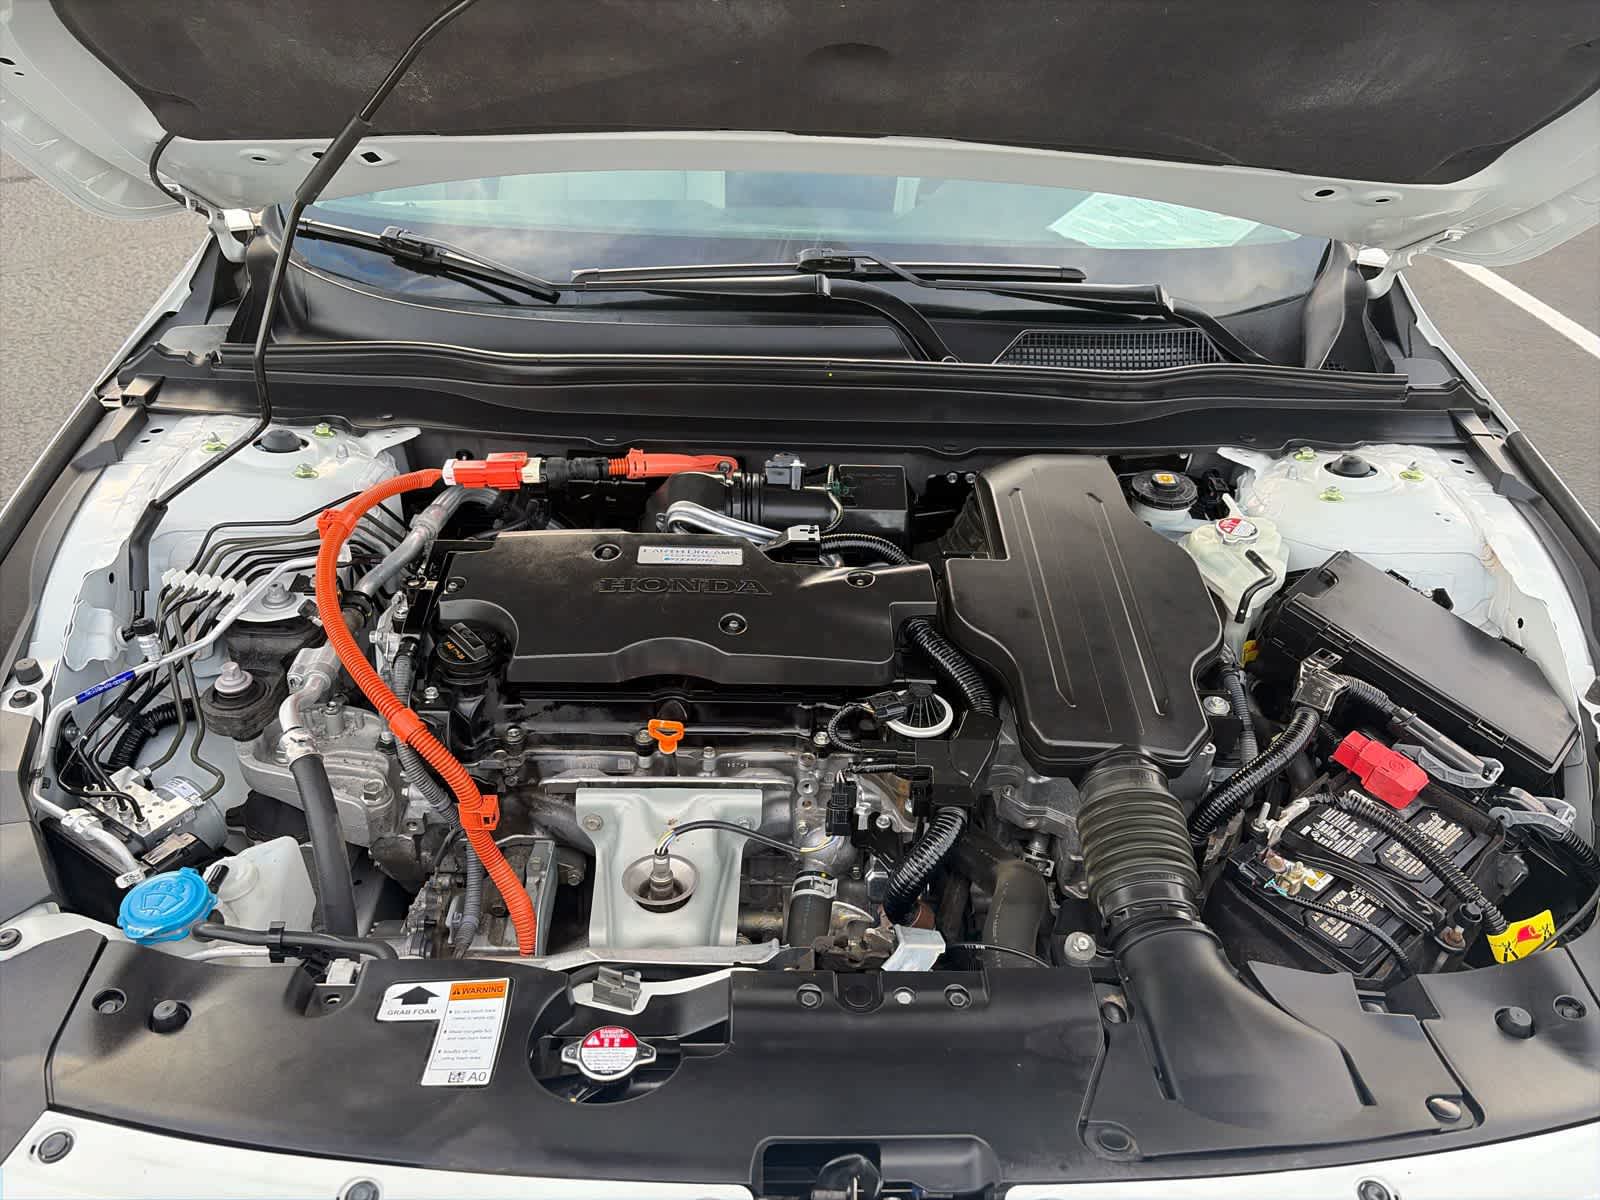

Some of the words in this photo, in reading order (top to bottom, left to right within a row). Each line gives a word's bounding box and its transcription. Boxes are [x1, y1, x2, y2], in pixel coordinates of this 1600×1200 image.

[599, 577, 772, 596] HONDA
[462, 984, 504, 996] WARNING
[387, 1008, 411, 1017] GRAB
[413, 1008, 437, 1016] FOAM
[465, 1071, 487, 1082] A0
